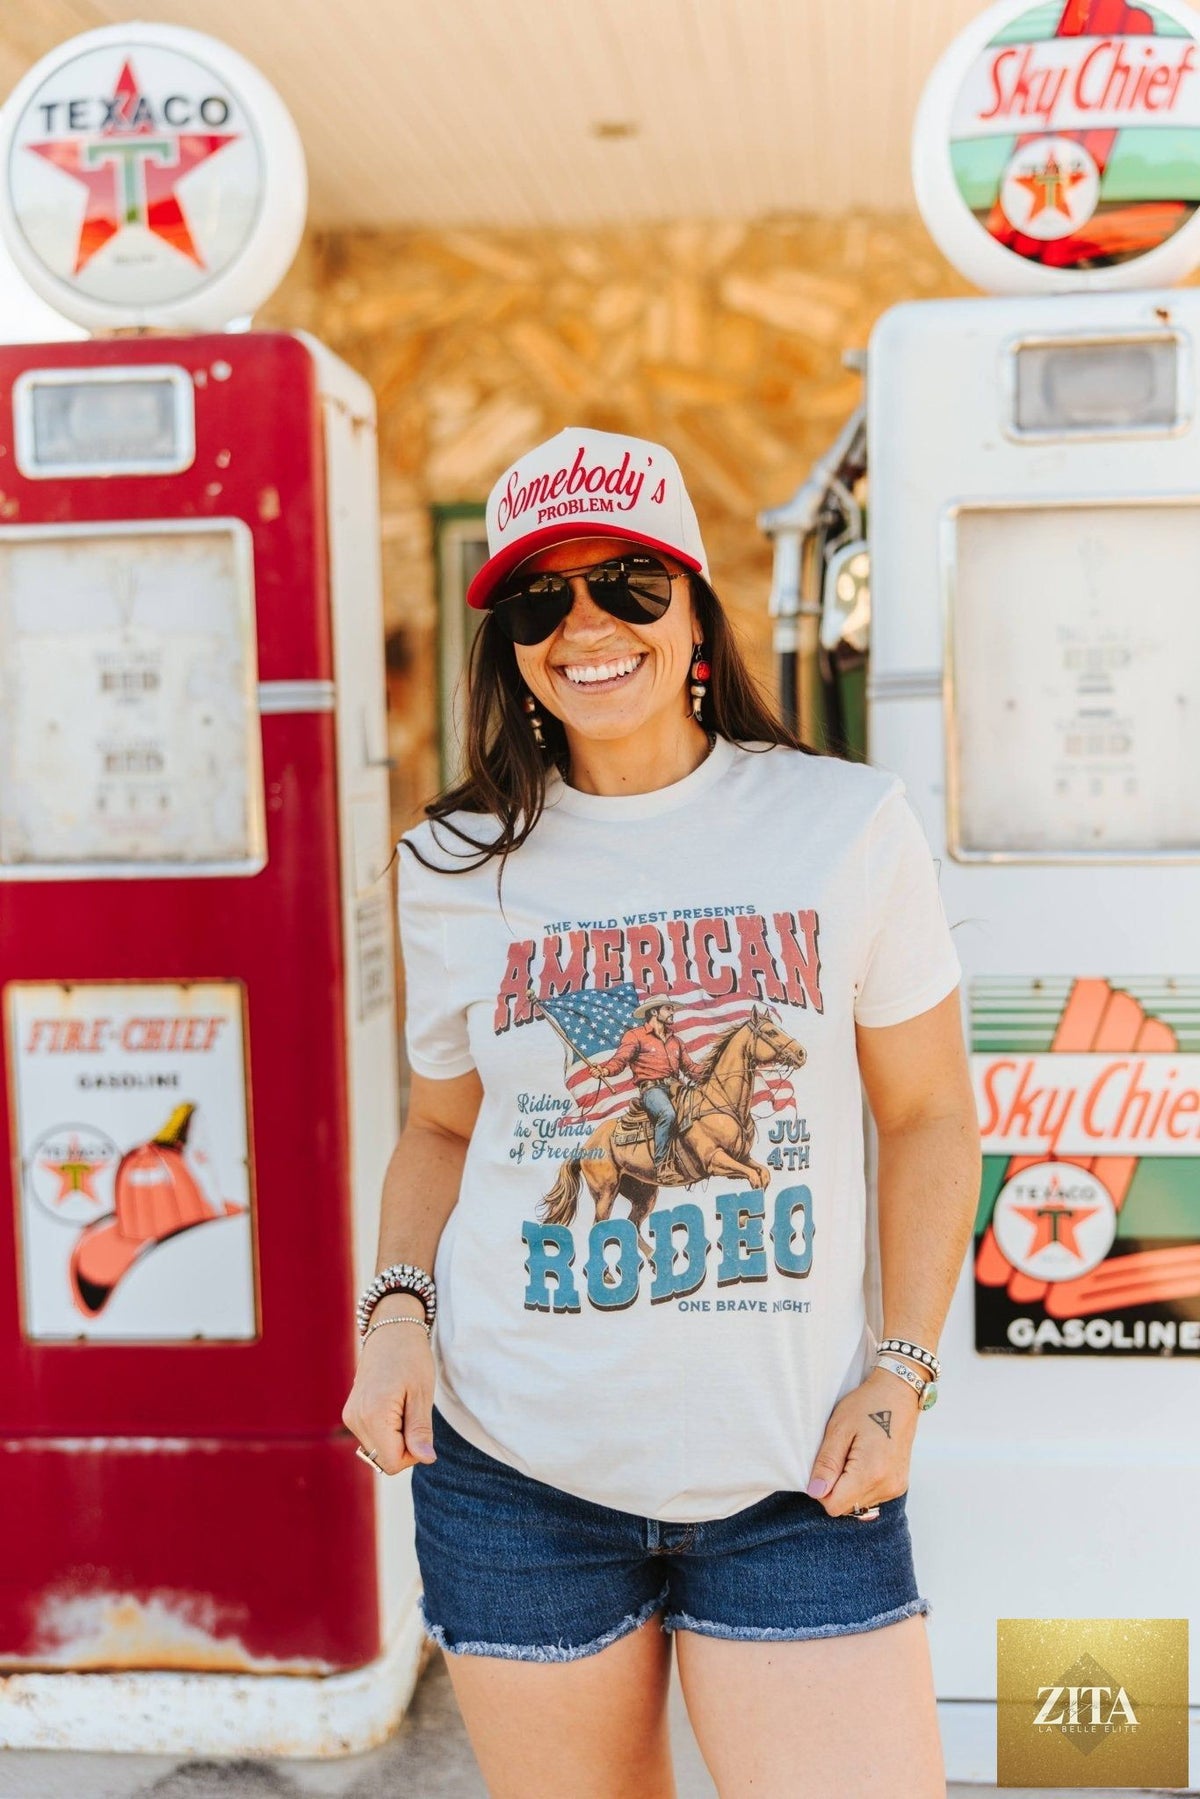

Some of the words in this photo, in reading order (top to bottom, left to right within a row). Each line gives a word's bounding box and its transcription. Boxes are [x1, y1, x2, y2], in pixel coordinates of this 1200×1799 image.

[979, 44, 1068, 126] Sky
[1075, 41, 1195, 109] Chief
[39, 94, 230, 132] TEXACO
[498, 447, 666, 532] Somebody's
[538, 498, 614, 524] PROBLEM
[544, 921, 572, 936] THE
[577, 918, 618, 930] WILD
[623, 911, 669, 926] WEST
[673, 904, 756, 920] PRESENTS
[494, 908, 824, 1035] AMERICAN
[517, 1092, 572, 1116] Riding
[980, 1061, 1076, 1153] Sky
[1082, 1061, 1200, 1138] Chie
[514, 1120, 531, 1138] he
[533, 1116, 594, 1138] Winds
[768, 1118, 810, 1144] JUL
[509, 1141, 525, 1164] of
[532, 1140, 605, 1160] Freedom
[767, 1145, 810, 1171] 4TH
[521, 1184, 816, 1313] RODEO
[678, 1300, 711, 1312] ONE
[716, 1300, 768, 1313] BRAVE
[1007, 1318, 1200, 1349] GASOLINE
